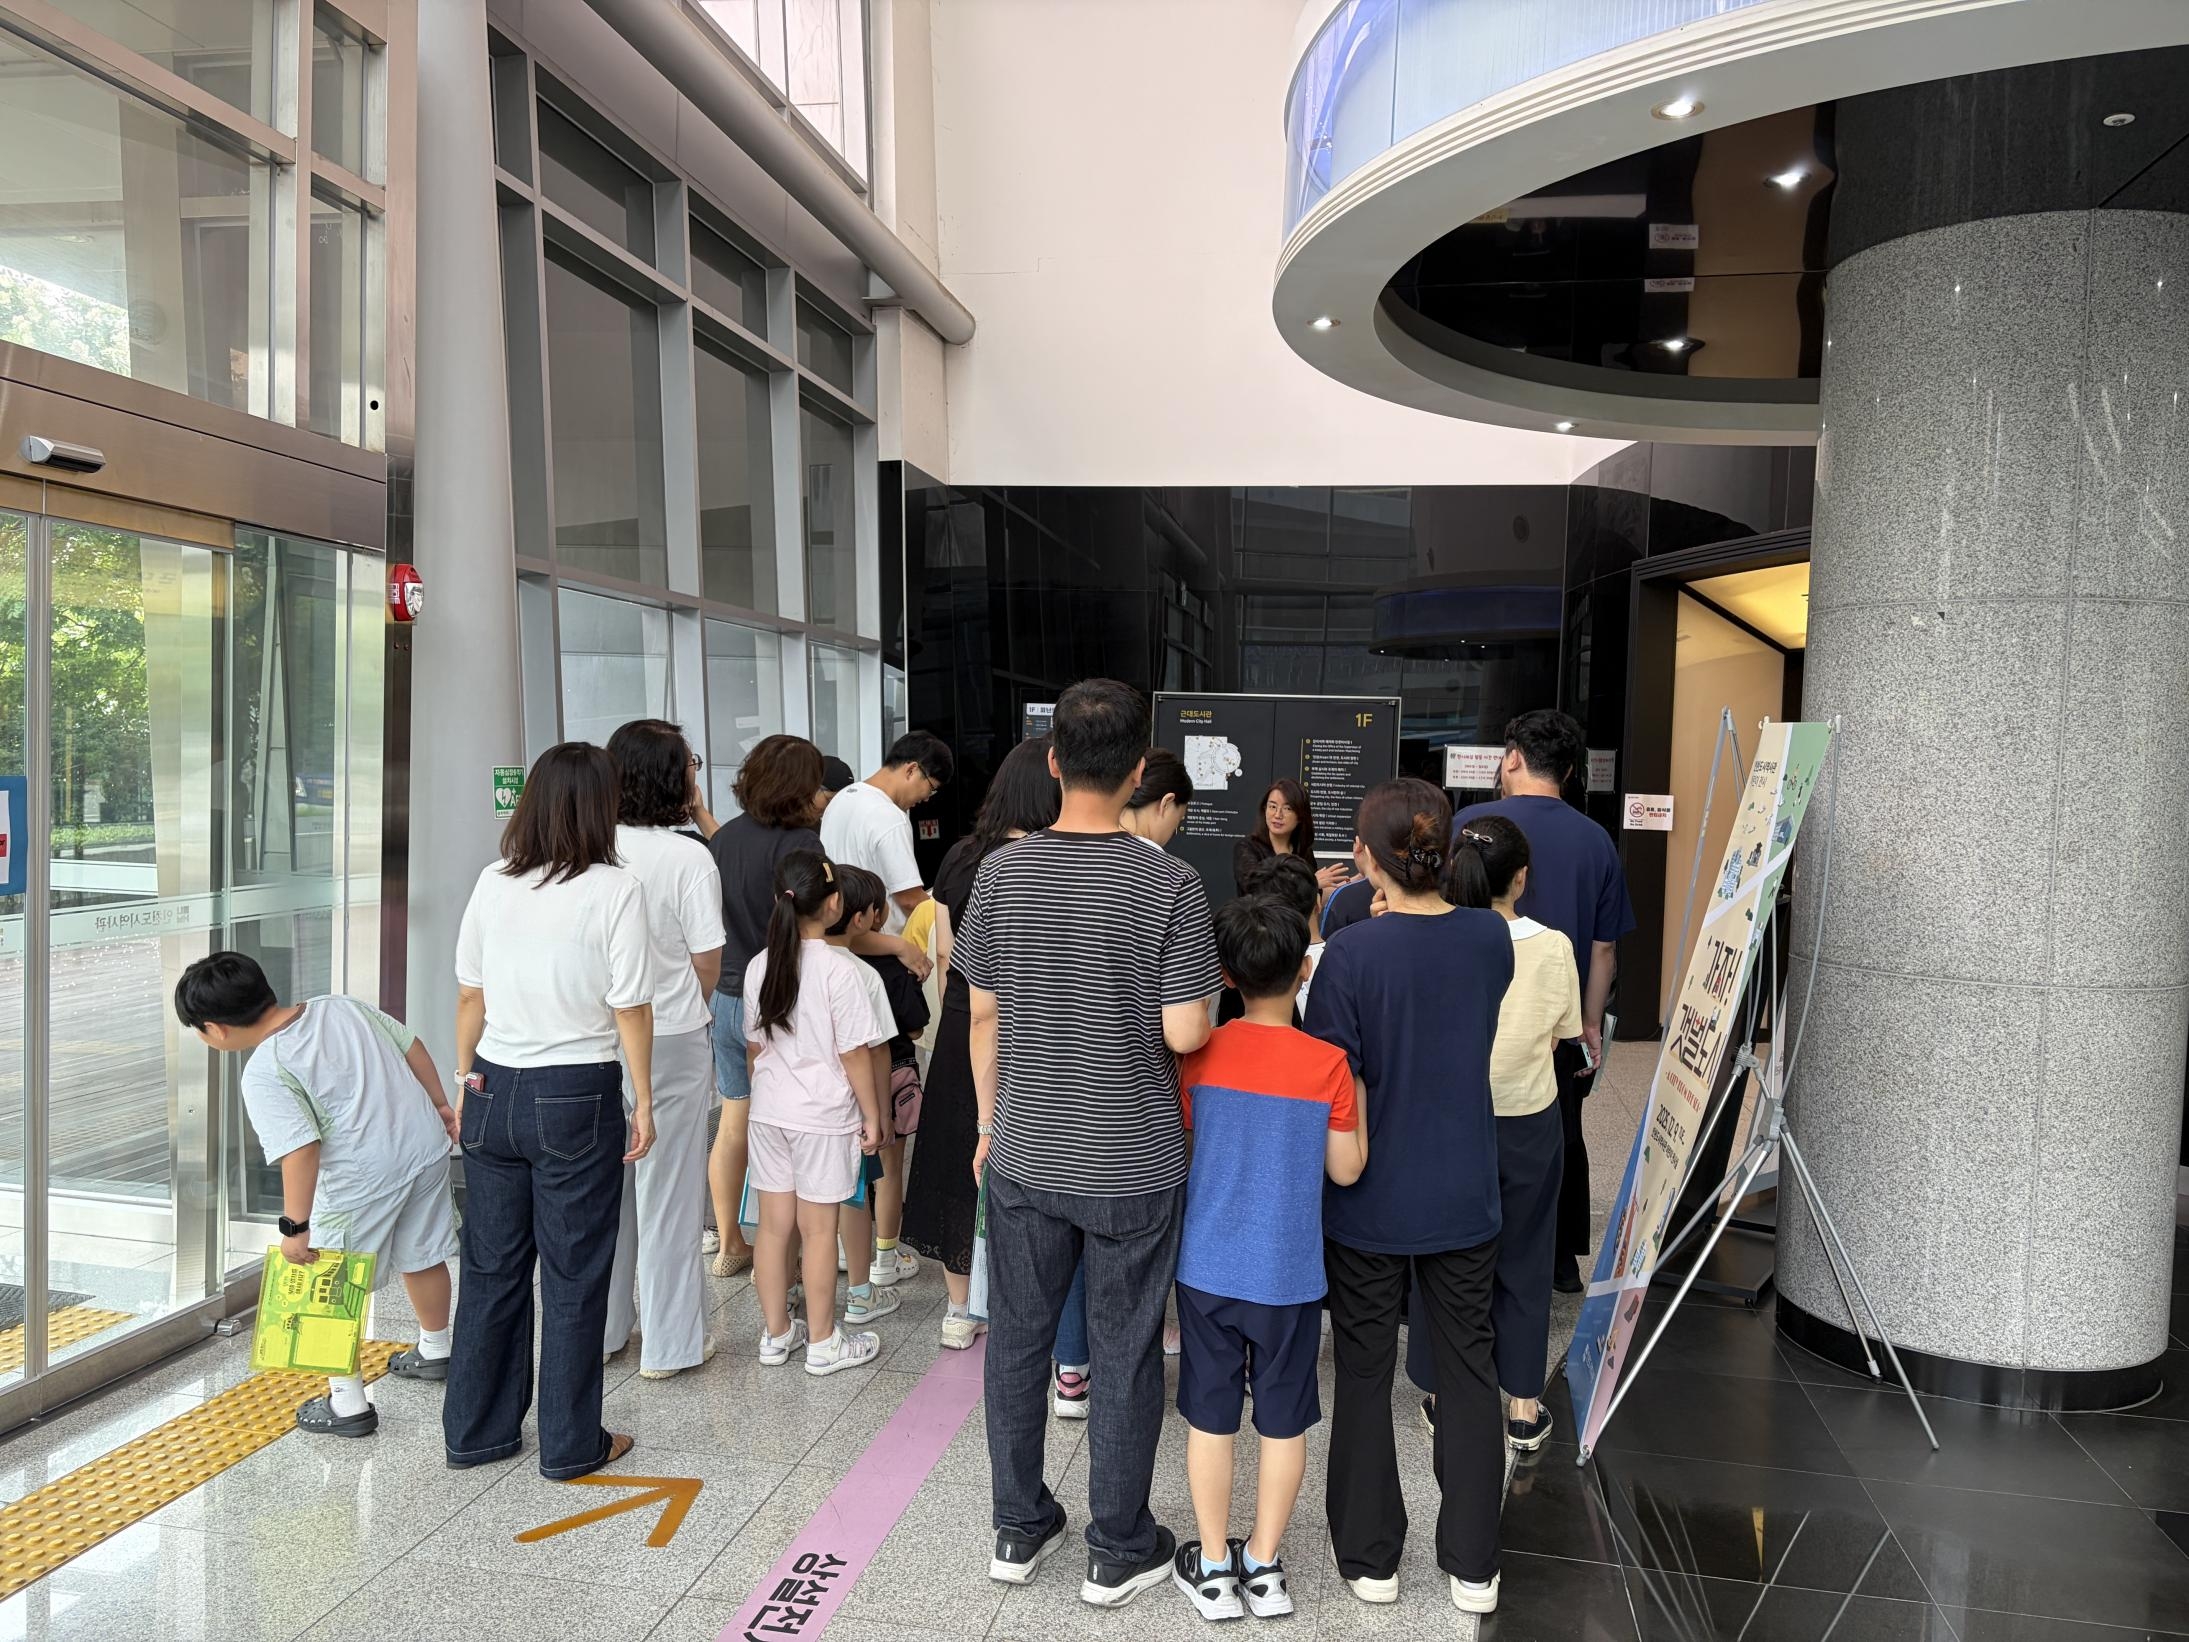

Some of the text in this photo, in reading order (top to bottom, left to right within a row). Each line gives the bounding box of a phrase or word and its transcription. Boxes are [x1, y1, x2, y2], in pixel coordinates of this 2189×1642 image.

[1180, 710, 1212, 718] 근대도시관
[1355, 713, 1373, 728] 1F
[1706, 940, 1743, 1007] 가자!
[1670, 1003, 1728, 1091] 갯벌도시
[743, 1552, 848, 1642] 상설전
